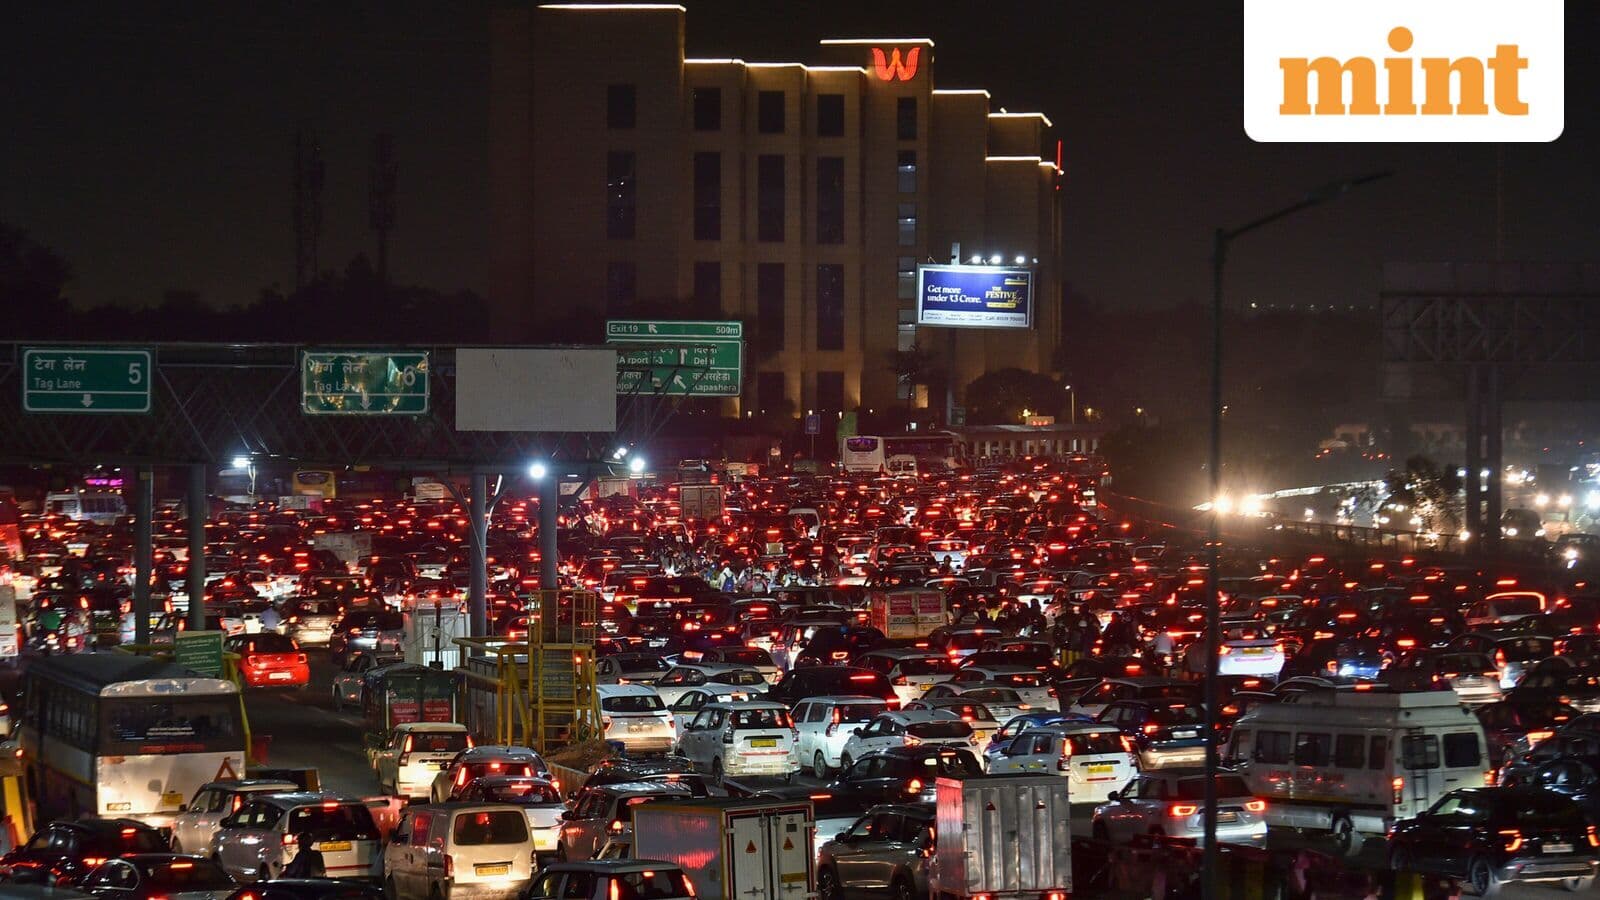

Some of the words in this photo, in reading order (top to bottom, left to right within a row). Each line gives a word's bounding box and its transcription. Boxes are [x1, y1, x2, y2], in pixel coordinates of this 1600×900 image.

[871, 47, 921, 82] W
[927, 284, 941, 293] Get
[943, 286, 962, 294] more
[985, 290, 1017, 299] FESTIVE
[927, 294, 948, 302] under
[610, 324, 627, 333] Exit
[628, 324, 639, 333] 19
[715, 326, 738, 335] 500m
[63, 356, 87, 371] लेन
[619, 356, 648, 365] Arport
[128, 362, 142, 385] 5
[402, 365, 416, 386] 6
[34, 377, 53, 390] Tag
[57, 379, 81, 389] Lane
[313, 380, 332, 392] Tag
[335, 381, 359, 391] La
